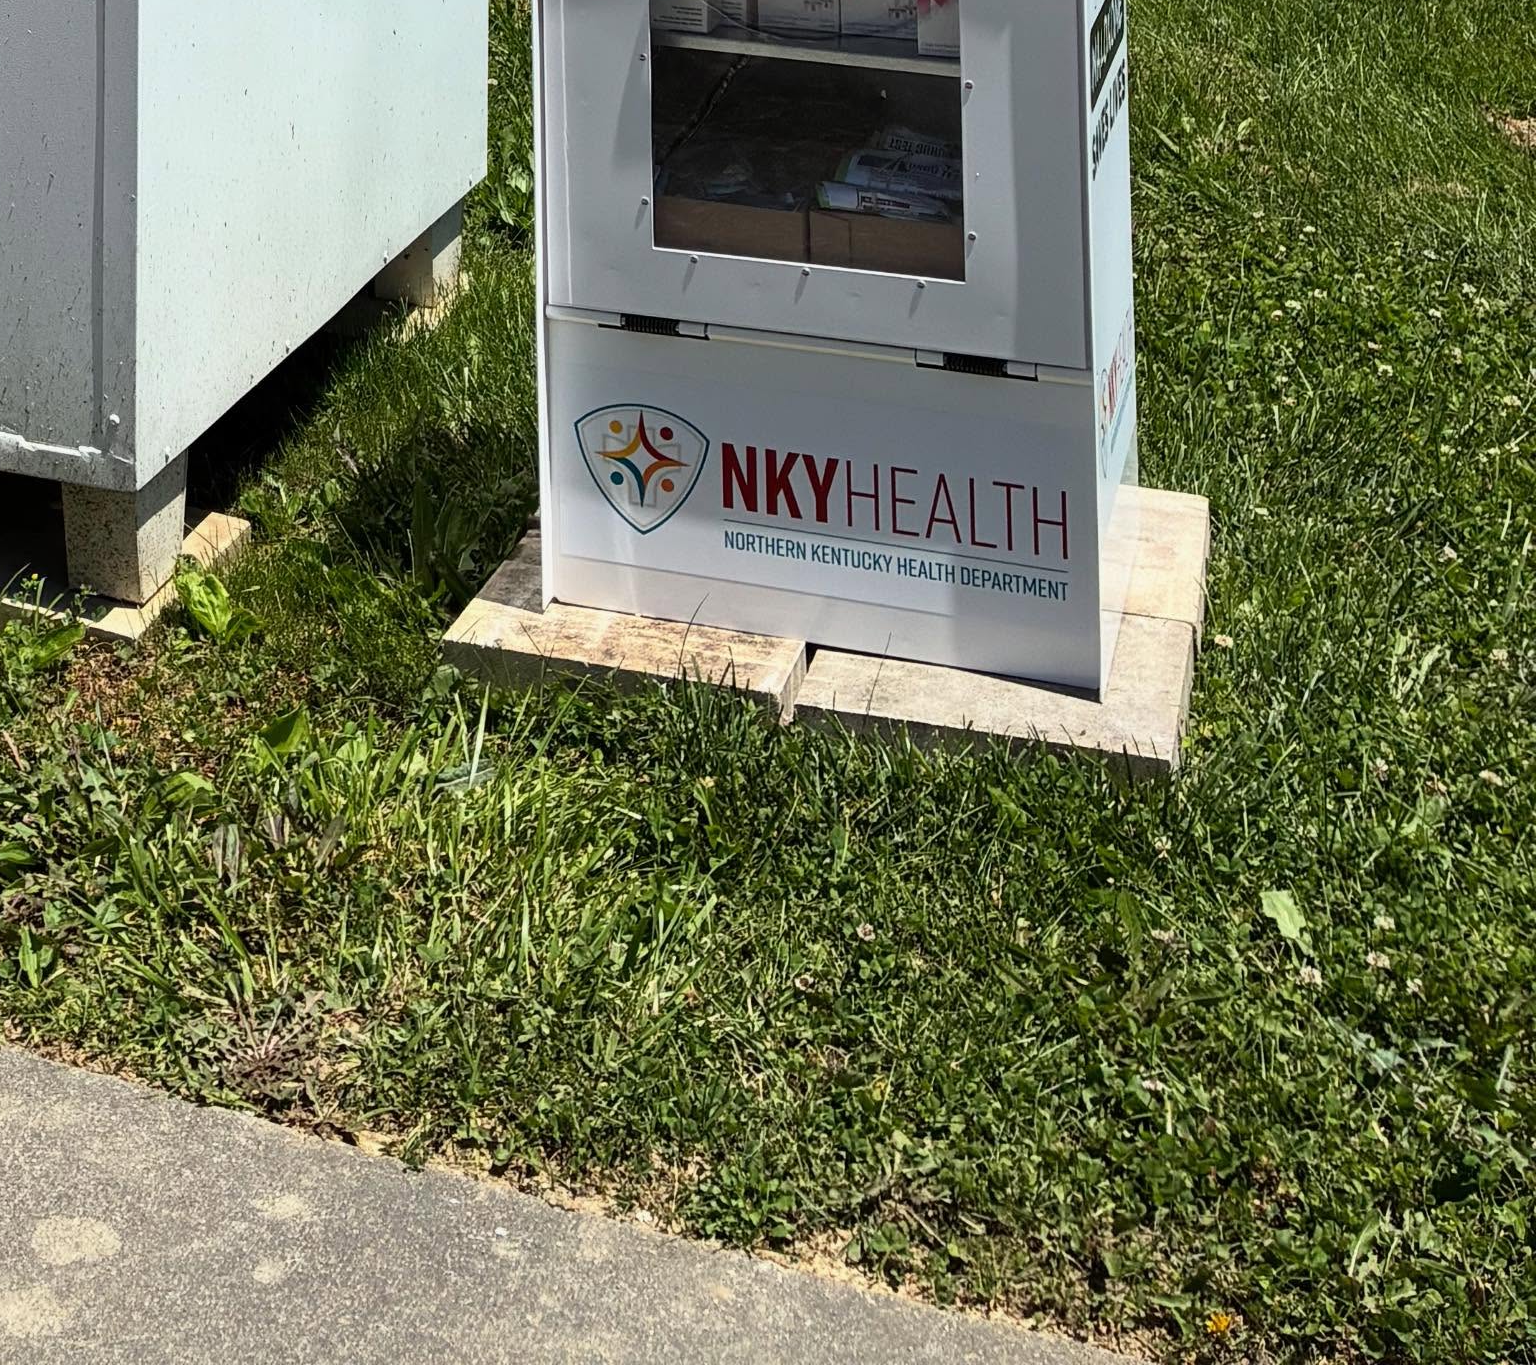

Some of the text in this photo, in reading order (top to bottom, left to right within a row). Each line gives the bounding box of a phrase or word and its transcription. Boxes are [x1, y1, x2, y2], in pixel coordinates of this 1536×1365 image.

[722, 442, 1070, 561] NKYHEALTH
[724, 530, 1070, 602] NORTHERN KENTUCKY HEALTH DEPARTMENT
